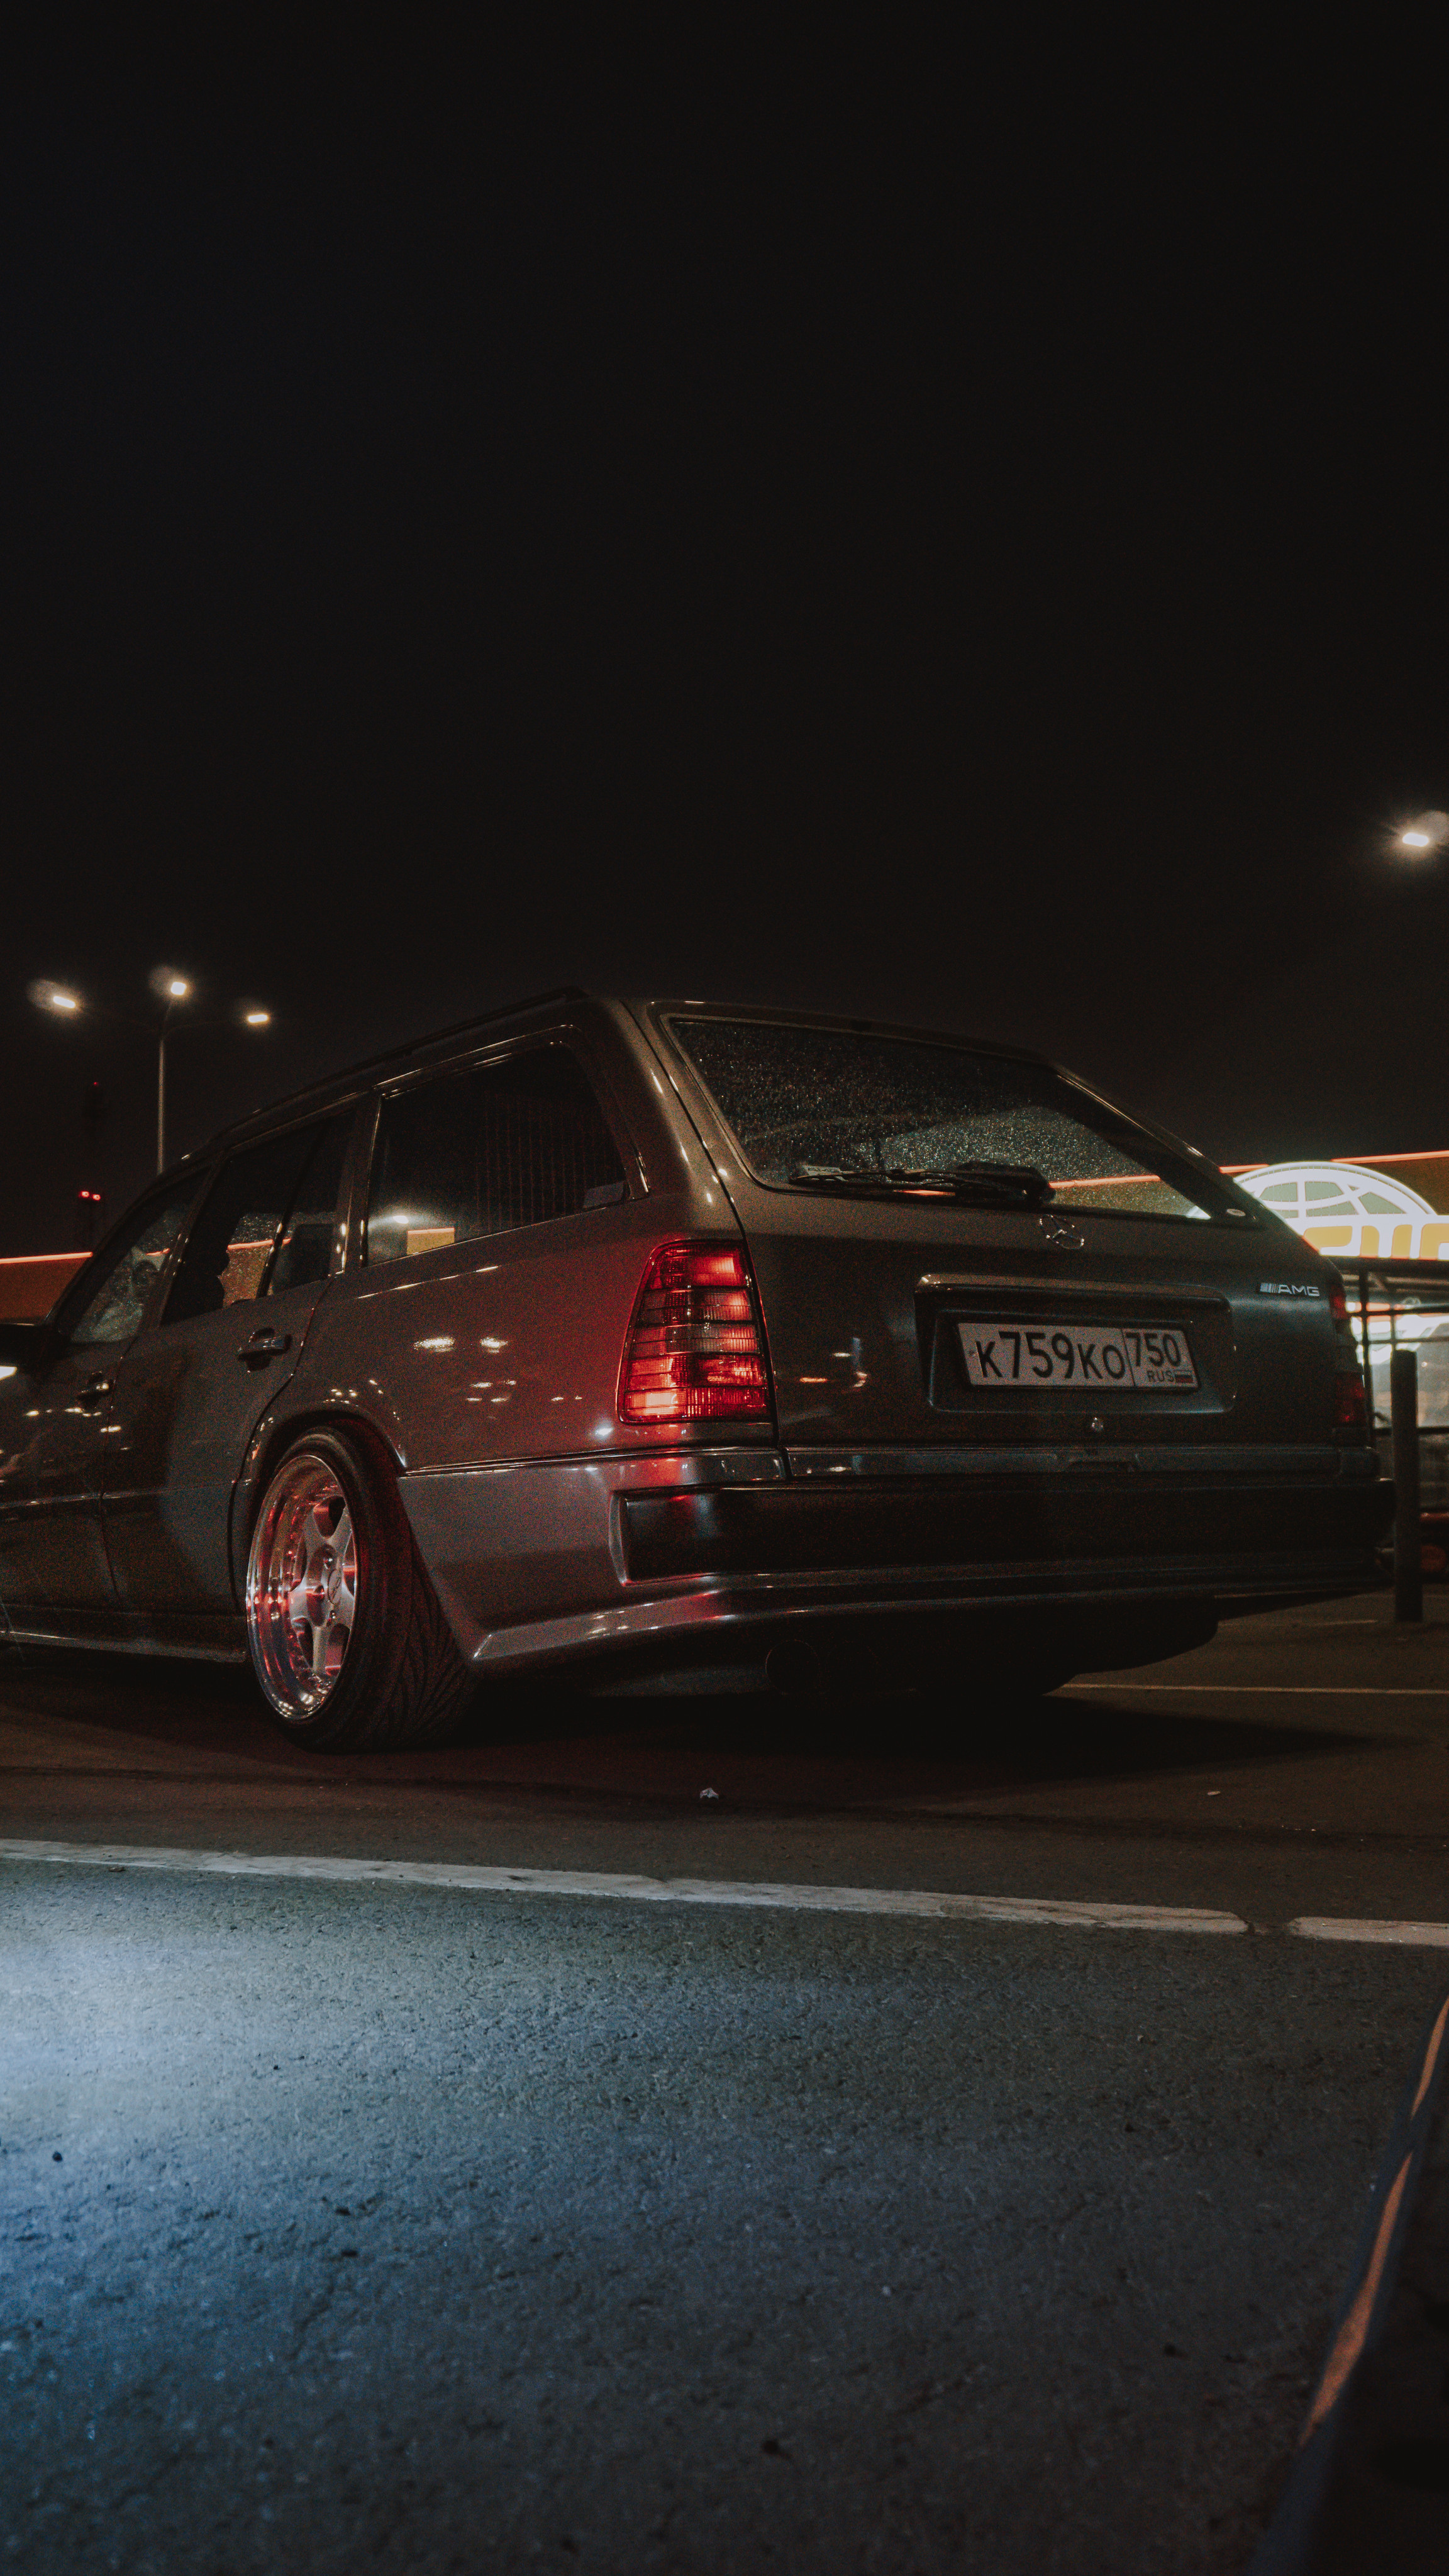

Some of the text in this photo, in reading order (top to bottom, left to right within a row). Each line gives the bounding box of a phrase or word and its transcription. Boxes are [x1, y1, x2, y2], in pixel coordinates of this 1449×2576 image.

[1277, 1284, 1320, 1296] AMG
[1126, 1332, 1182, 1367] 750
[1146, 1370, 1174, 1382] RUS
